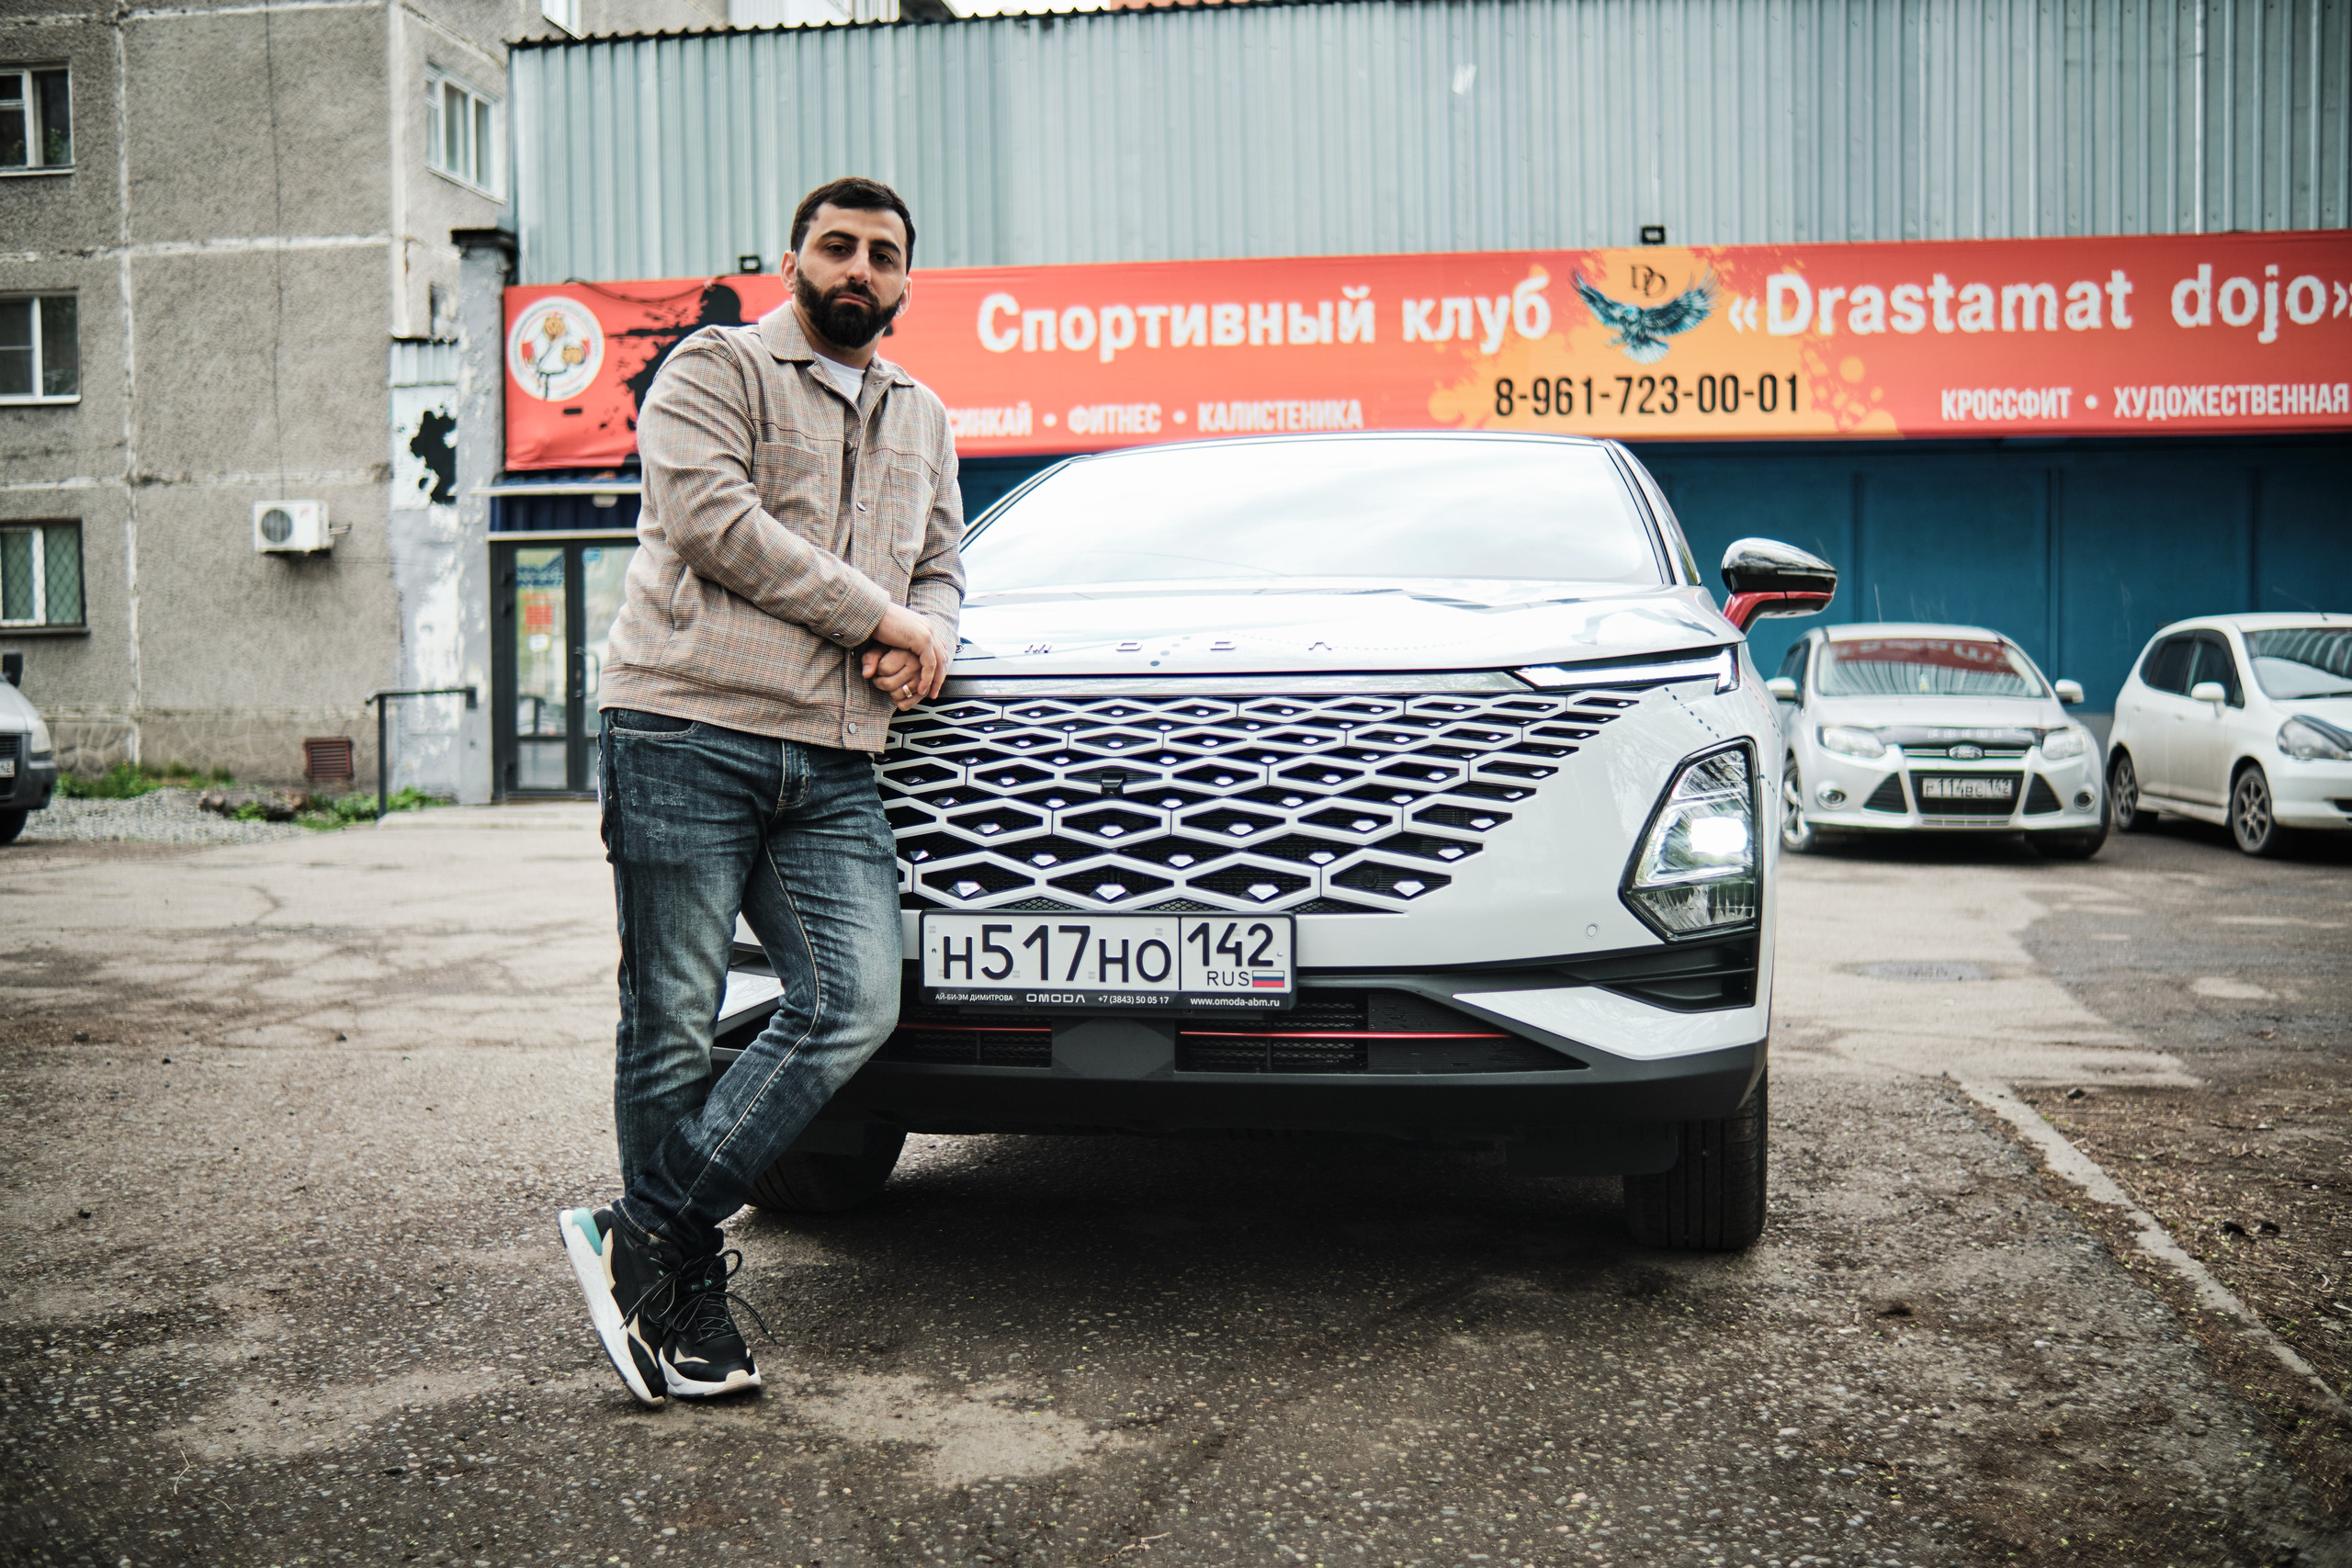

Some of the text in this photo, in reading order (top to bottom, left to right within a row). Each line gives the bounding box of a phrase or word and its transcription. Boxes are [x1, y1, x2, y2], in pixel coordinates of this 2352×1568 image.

[978, 276, 1552, 363] Спортивный клуб
[1728, 269, 2133, 335] «Drastamat
[1495, 371, 1799, 417] 8-961-723-00-01
[1940, 383, 2349, 422] КРОССФИТ ХУДОЖЕСТВЕННАЯ
[1067, 403, 1162, 435] ФИТНЕС
[1197, 399, 1364, 432] КАЛИСТЕНИКА
[943, 922, 1274, 984] Н517НО 142
[1206, 970, 1250, 987] RUS
[935, 992, 1013, 1002] АЙ-БИ-ЭМ ДИМИТРОВА
[1025, 993, 1086, 1003] OMODA
[1098, 995, 1170, 1005] +7 (3843) 50 05 17
[1190, 998, 1280, 1007] www.omoda-abm.ru
